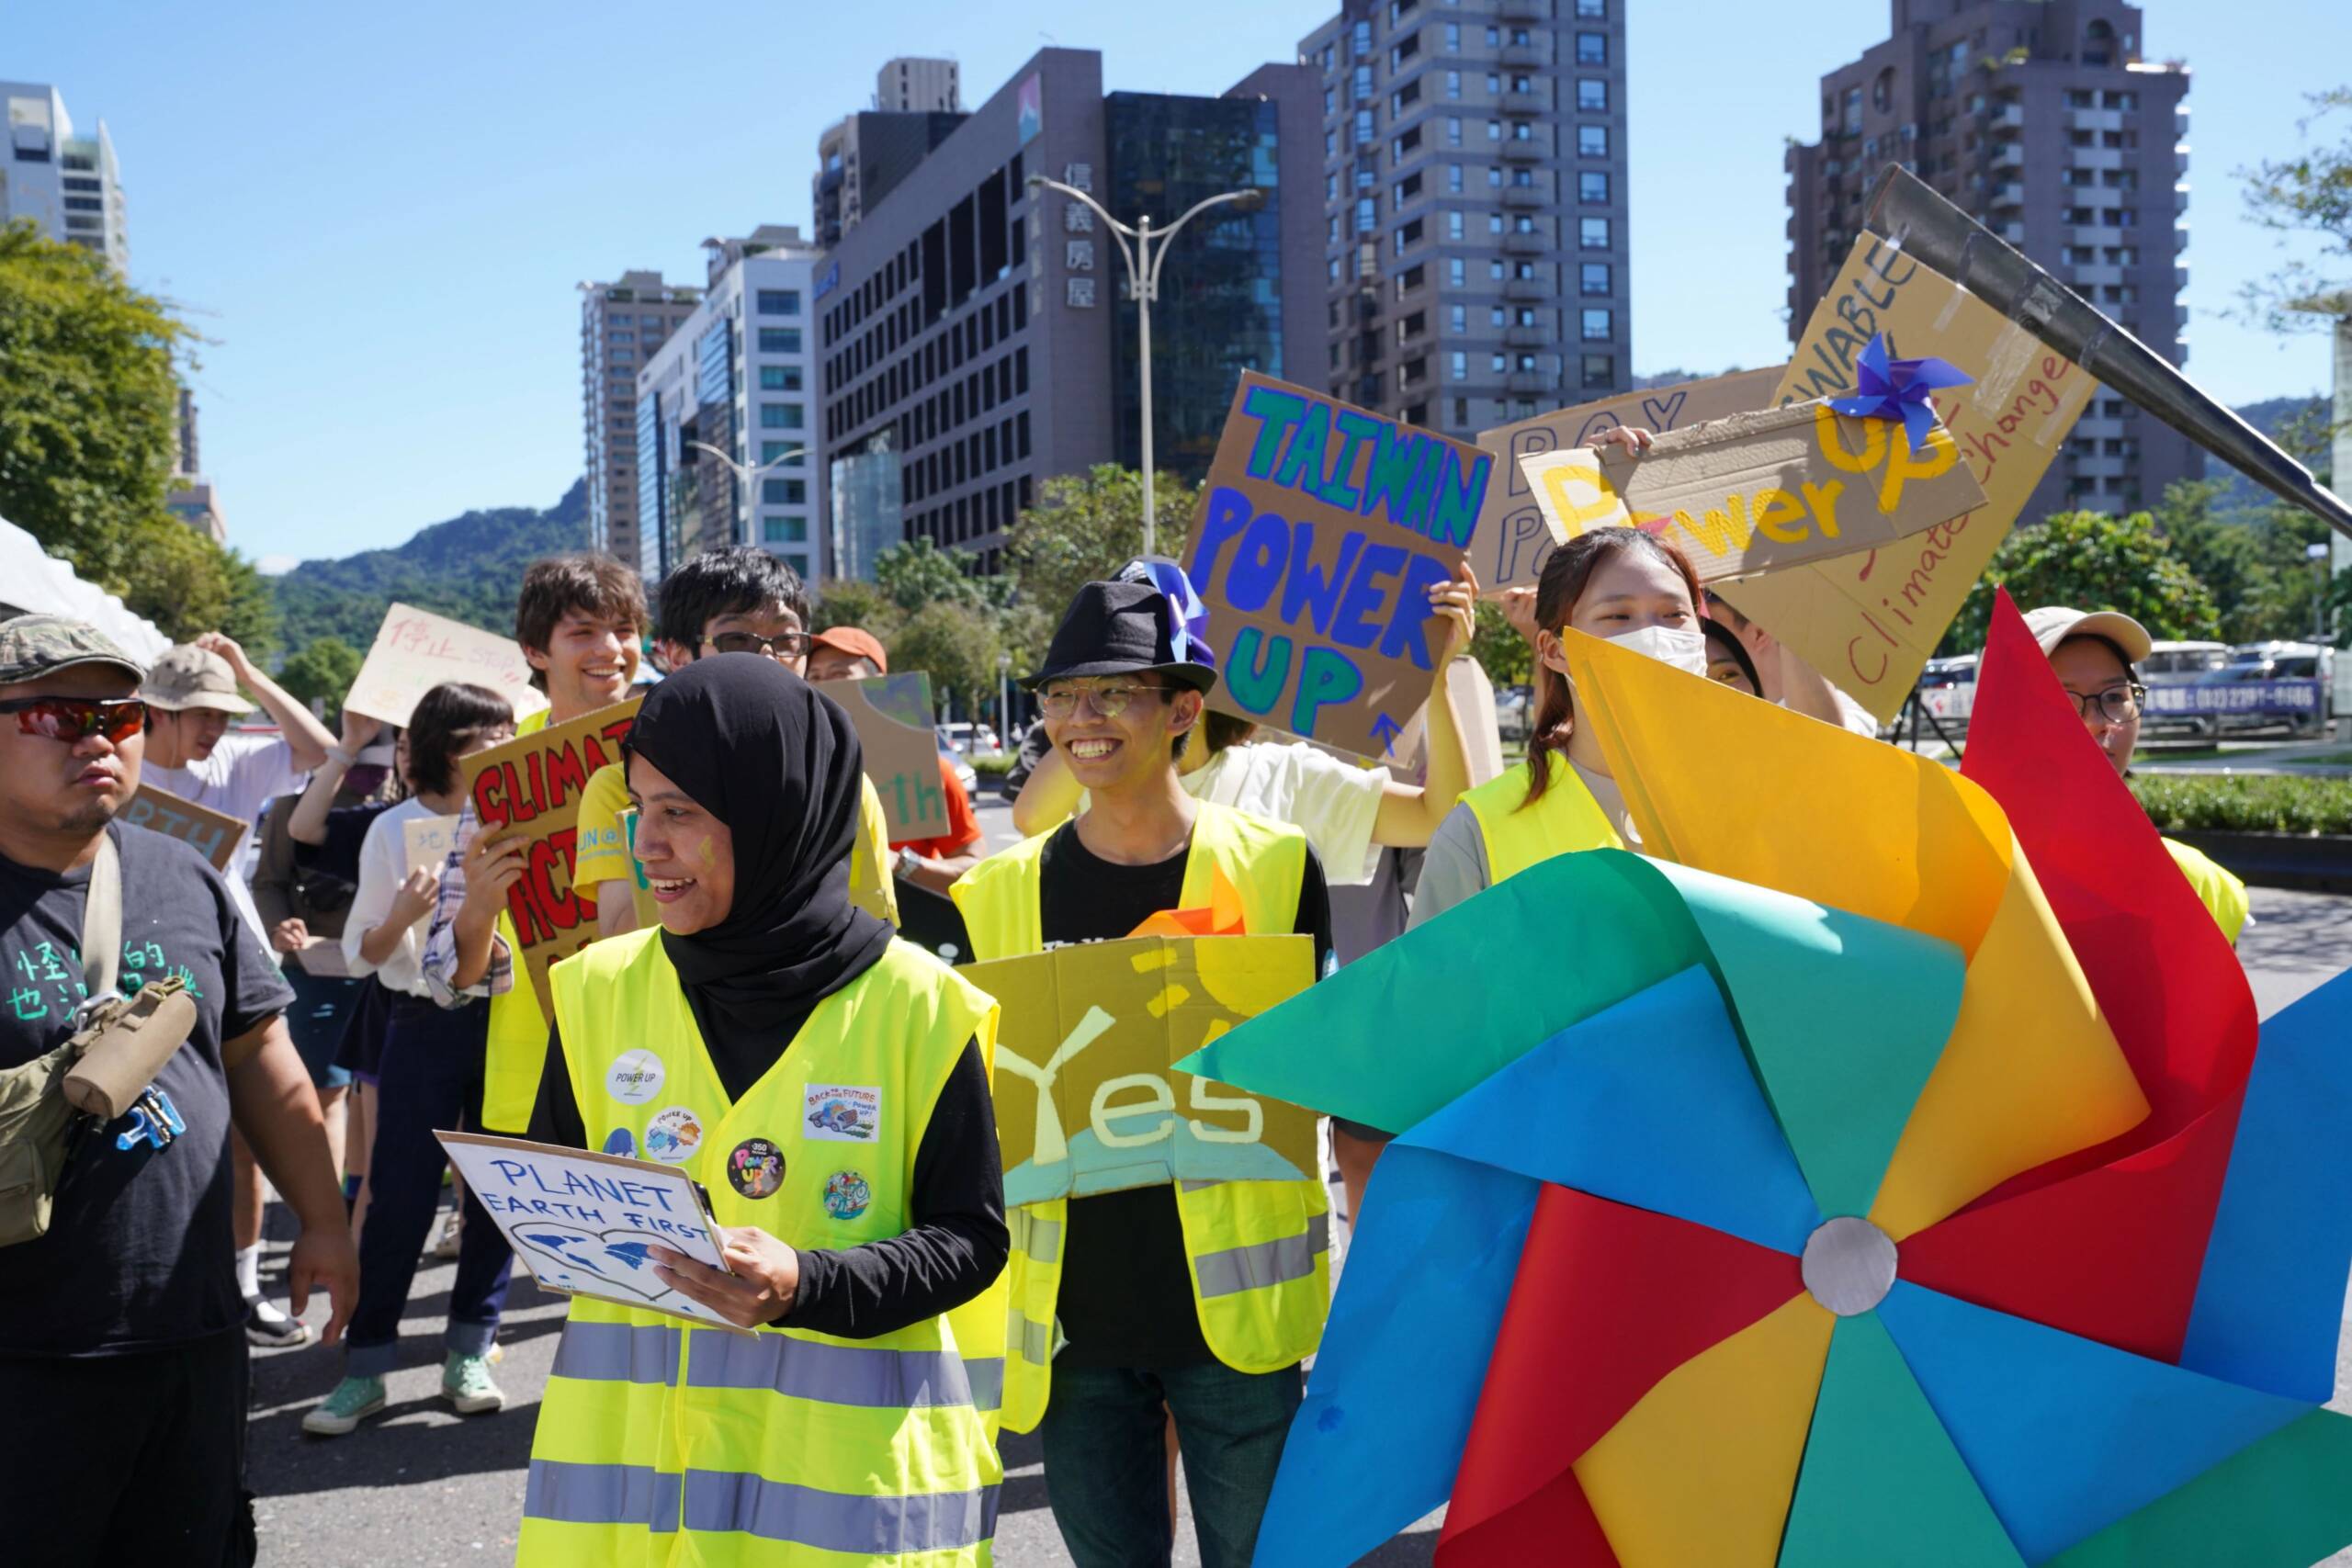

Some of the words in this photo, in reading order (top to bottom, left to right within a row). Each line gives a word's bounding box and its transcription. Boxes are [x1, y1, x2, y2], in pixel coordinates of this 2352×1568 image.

[1243, 384, 1493, 549] TAIWAN
[1187, 486, 1457, 672] POWER
[1849, 510, 1971, 685] Climate
[390, 619, 461, 660] 停止
[1225, 626, 1364, 737] UP
[473, 716, 638, 829] CLIMAT
[616, 1073, 644, 1082] POWER
[645, 1073, 656, 1082] UP
[808, 1090, 831, 1106] BACK
[843, 1089, 876, 1103] FUTURE
[995, 1005, 1264, 1167] Yes
[490, 1159, 673, 1213] PLANET
[752, 1143, 768, 1152] 350
[481, 1193, 606, 1224] EARTH
[623, 1213, 710, 1243] FIRST
